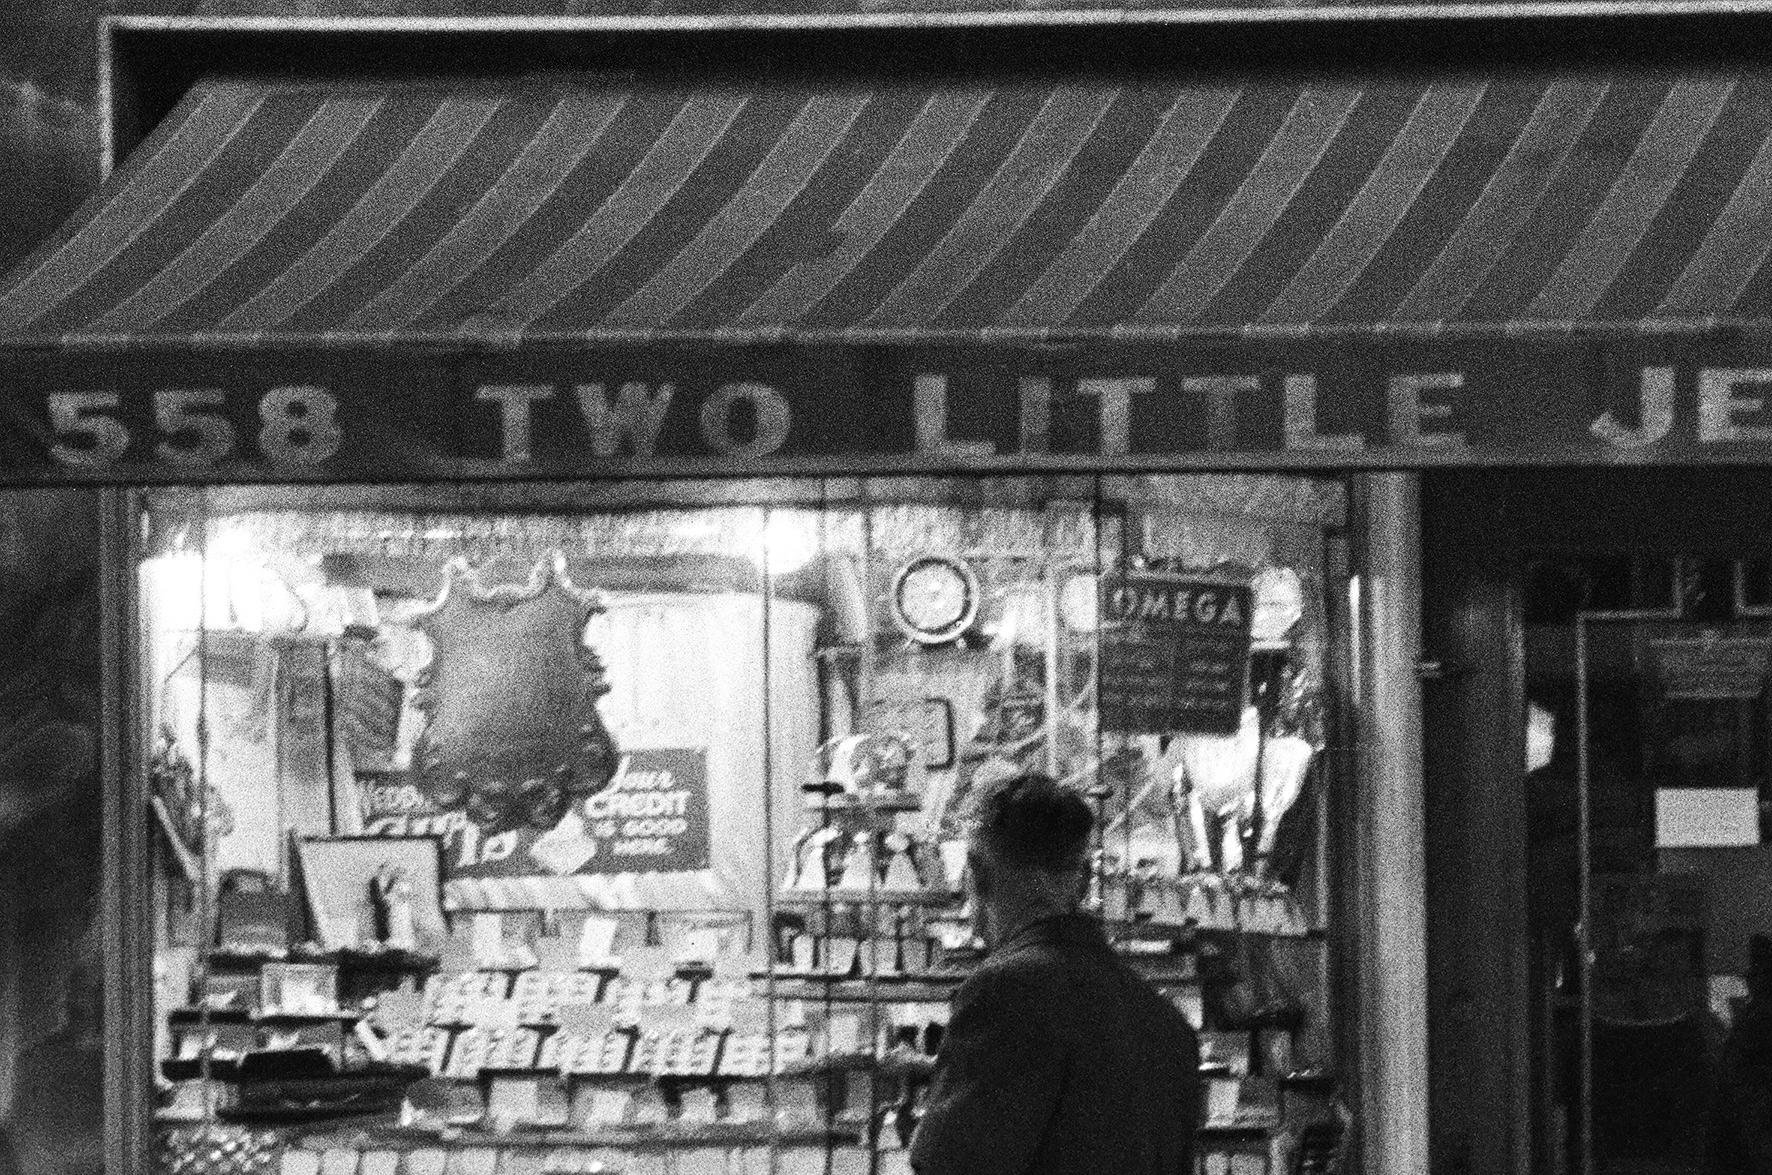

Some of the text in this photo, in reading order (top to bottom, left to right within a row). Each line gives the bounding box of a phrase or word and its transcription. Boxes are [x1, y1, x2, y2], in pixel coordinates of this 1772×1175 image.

[47, 387, 342, 468] 558
[474, 382, 793, 463] TWO
[912, 370, 1467, 456] LITTLE
[1112, 585, 1243, 626] OMEGA
[585, 790, 691, 818] CREDIT
